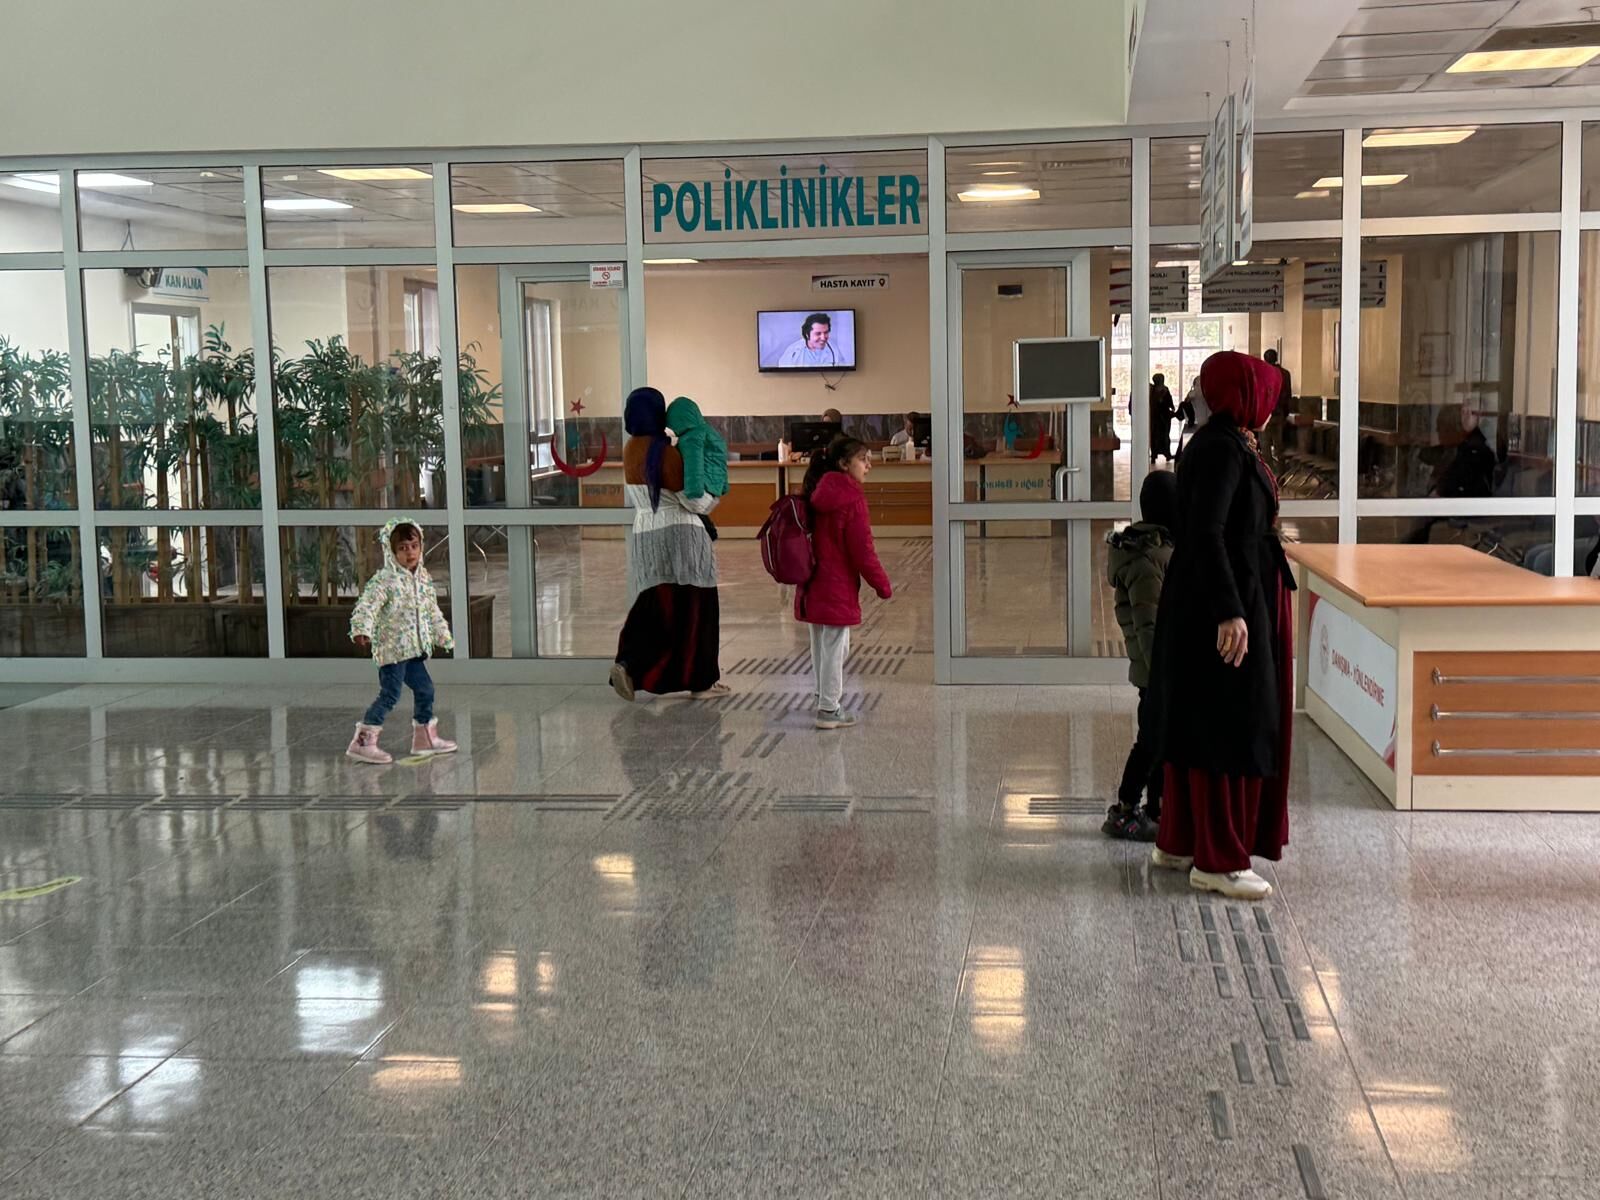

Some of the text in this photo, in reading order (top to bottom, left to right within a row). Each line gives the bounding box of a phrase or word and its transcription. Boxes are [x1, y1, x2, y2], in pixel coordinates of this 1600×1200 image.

[653, 164, 920, 232] POLİKLİNİKLER
[166, 274, 181, 288] KAN
[820, 279, 875, 288] HASTA KAYIT
